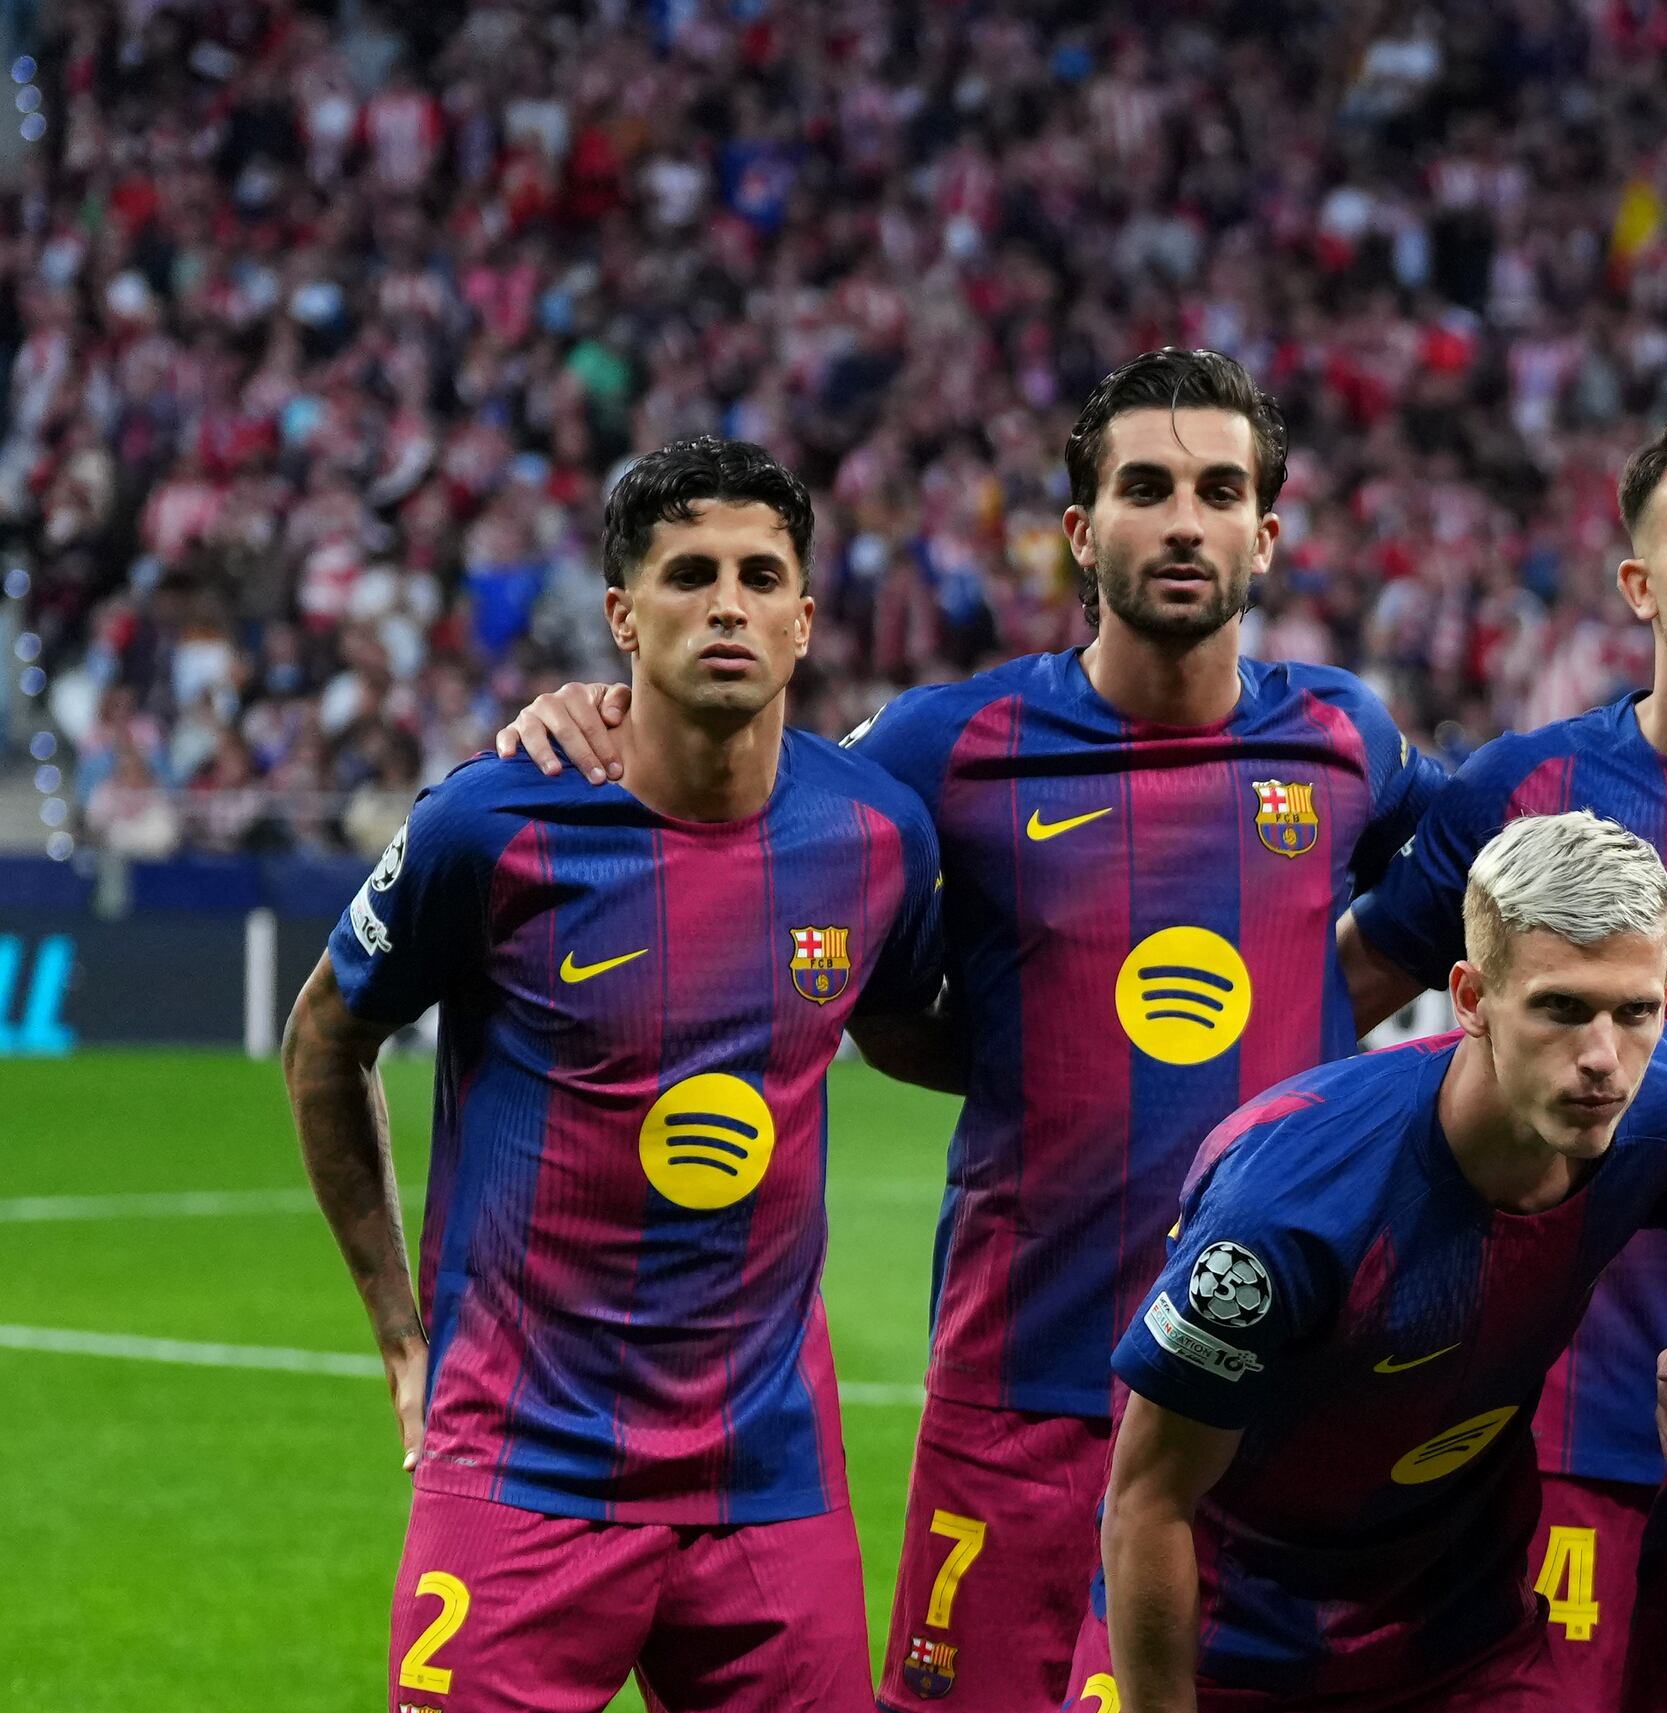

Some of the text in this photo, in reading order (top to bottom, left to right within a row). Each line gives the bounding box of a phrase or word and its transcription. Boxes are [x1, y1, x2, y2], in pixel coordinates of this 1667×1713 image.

[1213, 1271, 1243, 1301] 5
[925, 1509, 987, 1629] 7
[1533, 1525, 1600, 1641] 4
[399, 1570, 471, 1695] 2
